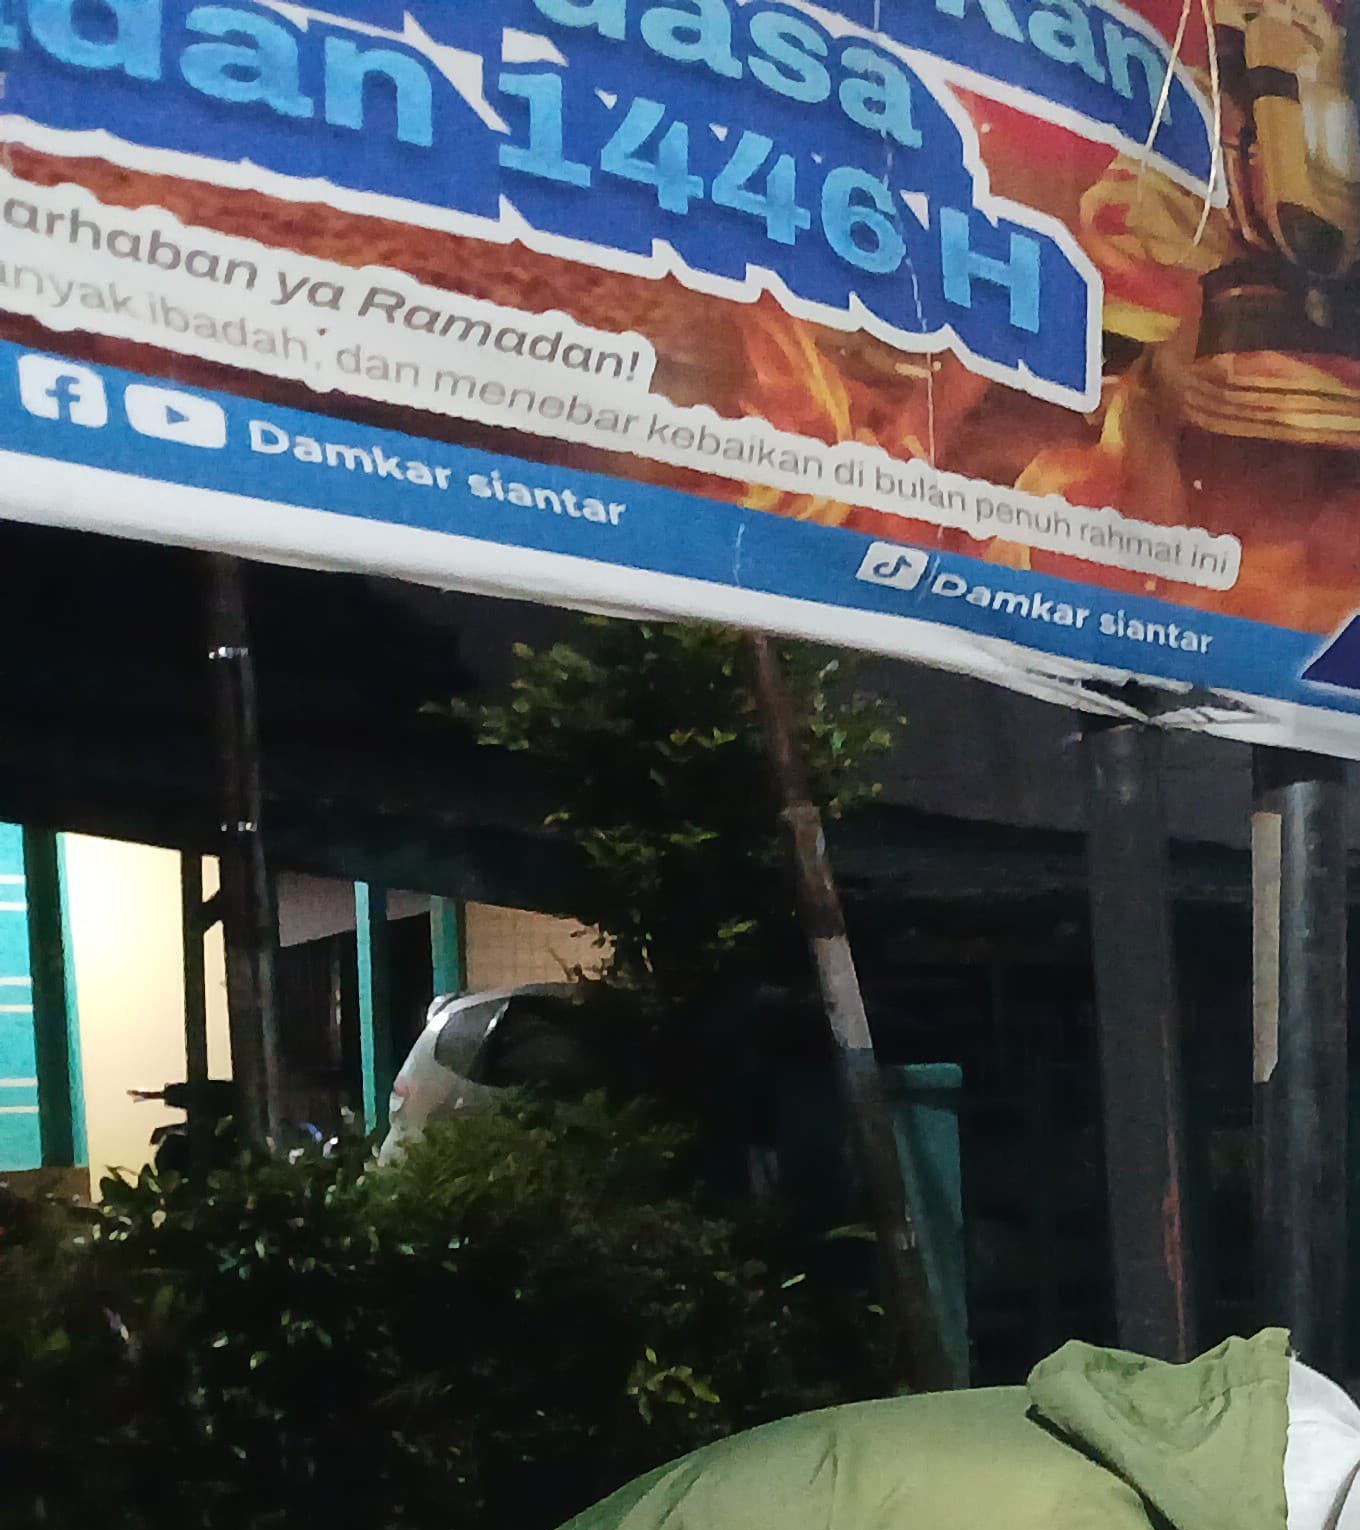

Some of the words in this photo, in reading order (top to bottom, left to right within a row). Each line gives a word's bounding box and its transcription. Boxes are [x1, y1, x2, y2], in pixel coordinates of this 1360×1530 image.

[3, 197, 258, 290] arhaban
[270, 270, 344, 312] ya
[357, 285, 640, 382] Ramadan!
[499, 73, 906, 275] 1446
[940, 205, 1042, 333] H
[248, 420, 452, 490] Damkar
[467, 470, 626, 527] siantar
[336, 344, 420, 388] dan
[434, 369, 640, 435] menebar
[647, 413, 823, 479] kebaikan
[834, 459, 864, 488] di
[875, 466, 966, 512] bulan
[976, 497, 1071, 540] penuh
[1079, 522, 1182, 559] rahmat
[1190, 543, 1228, 575] ini
[931, 572, 1091, 630] Damkar
[1100, 609, 1214, 655] siantar
